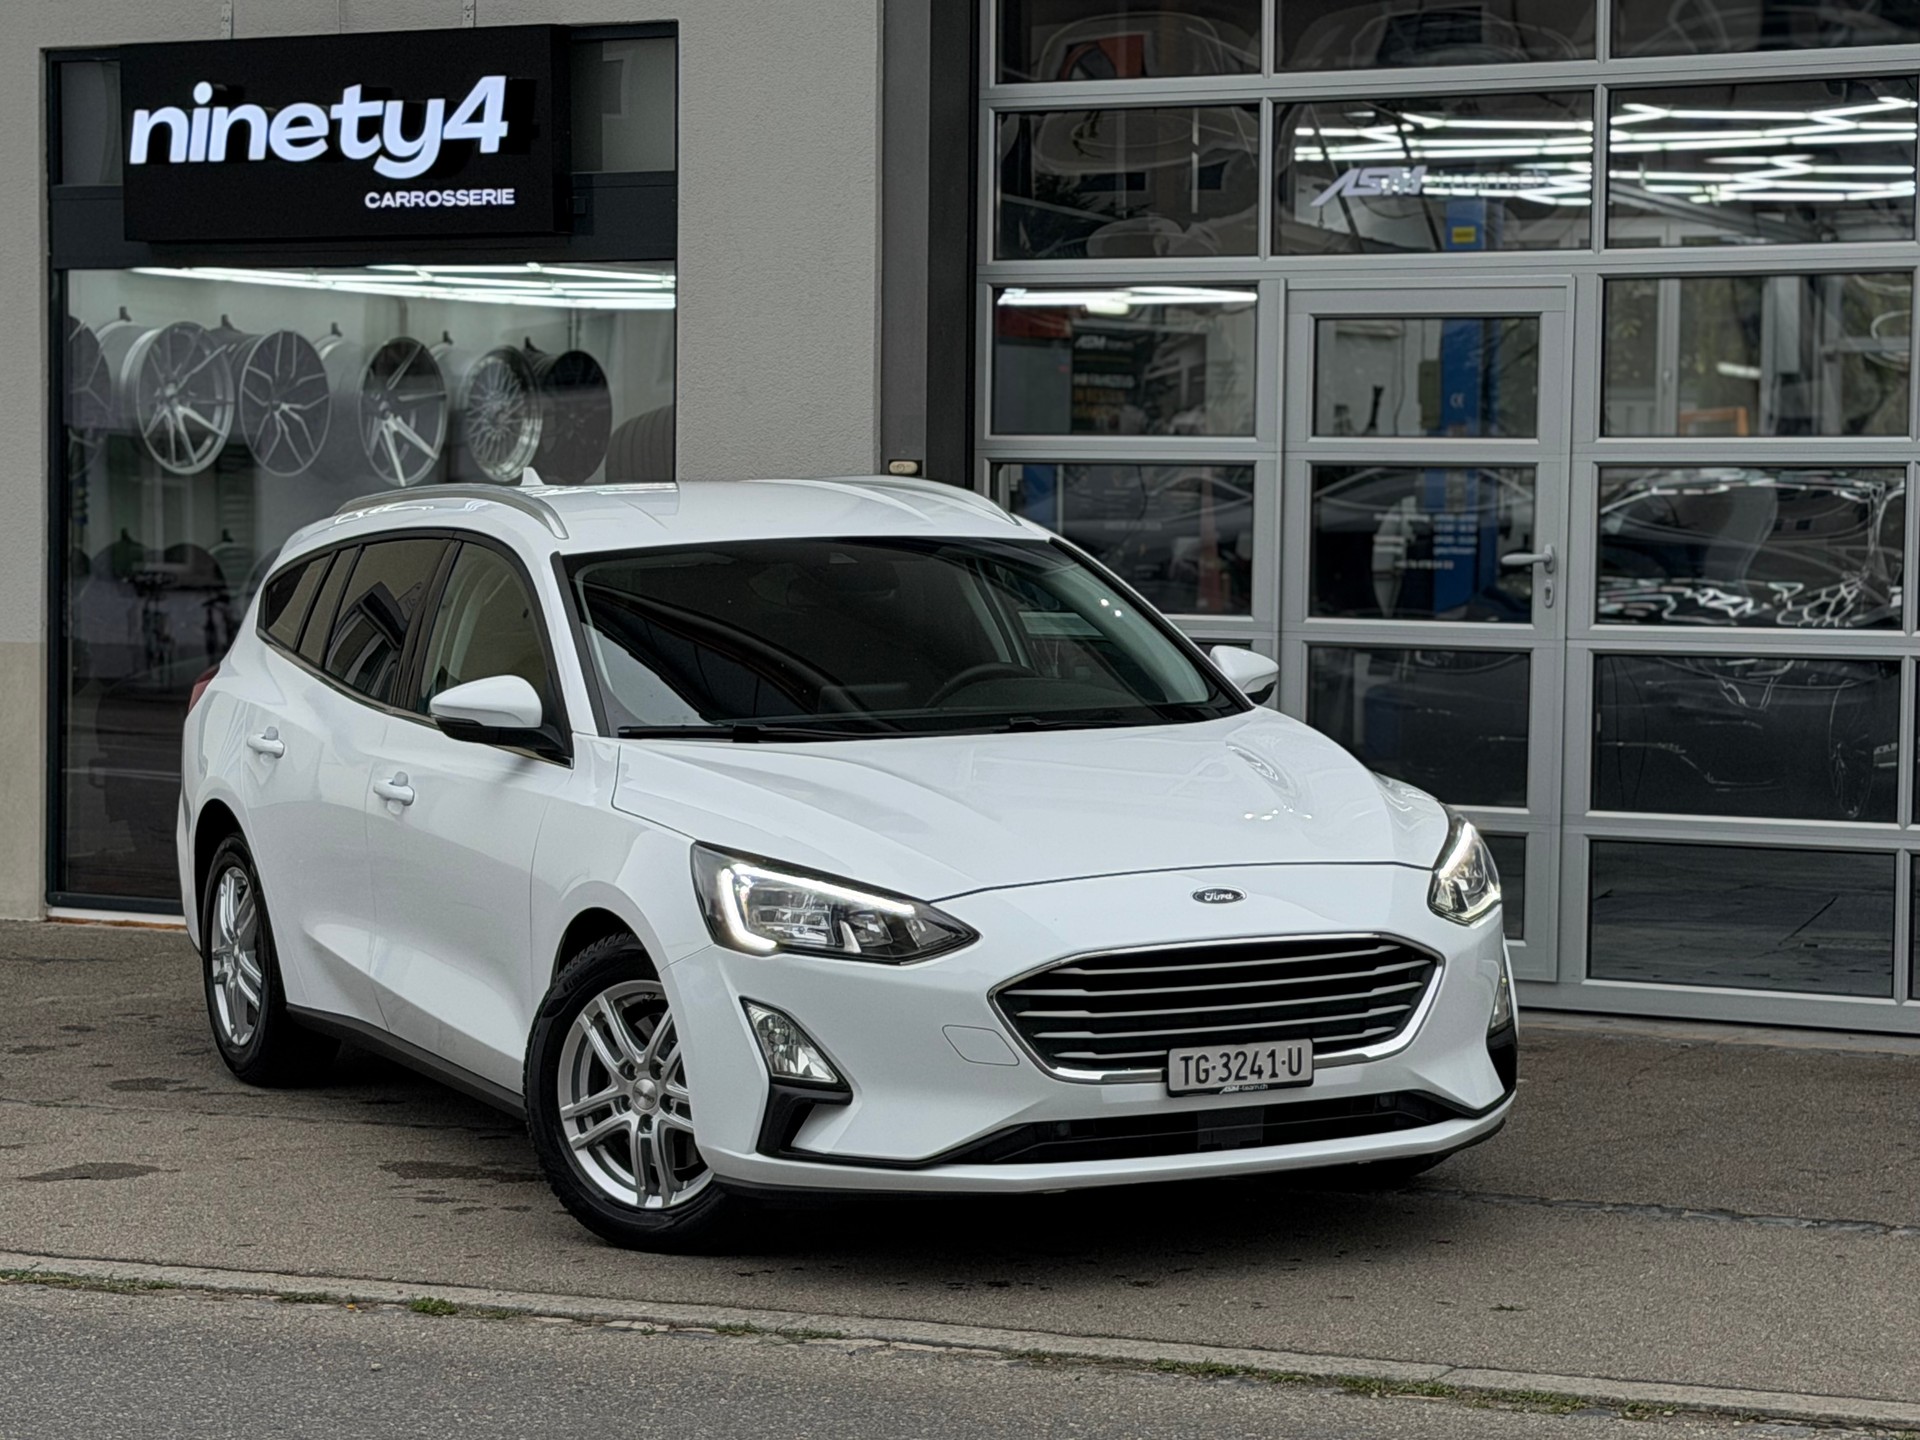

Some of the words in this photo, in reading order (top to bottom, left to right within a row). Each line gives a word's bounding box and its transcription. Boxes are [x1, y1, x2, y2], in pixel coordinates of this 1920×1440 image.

[129, 75, 508, 179] ninety4
[364, 188, 515, 208] CARROSSERIE
[1203, 891, 1235, 902] Ford
